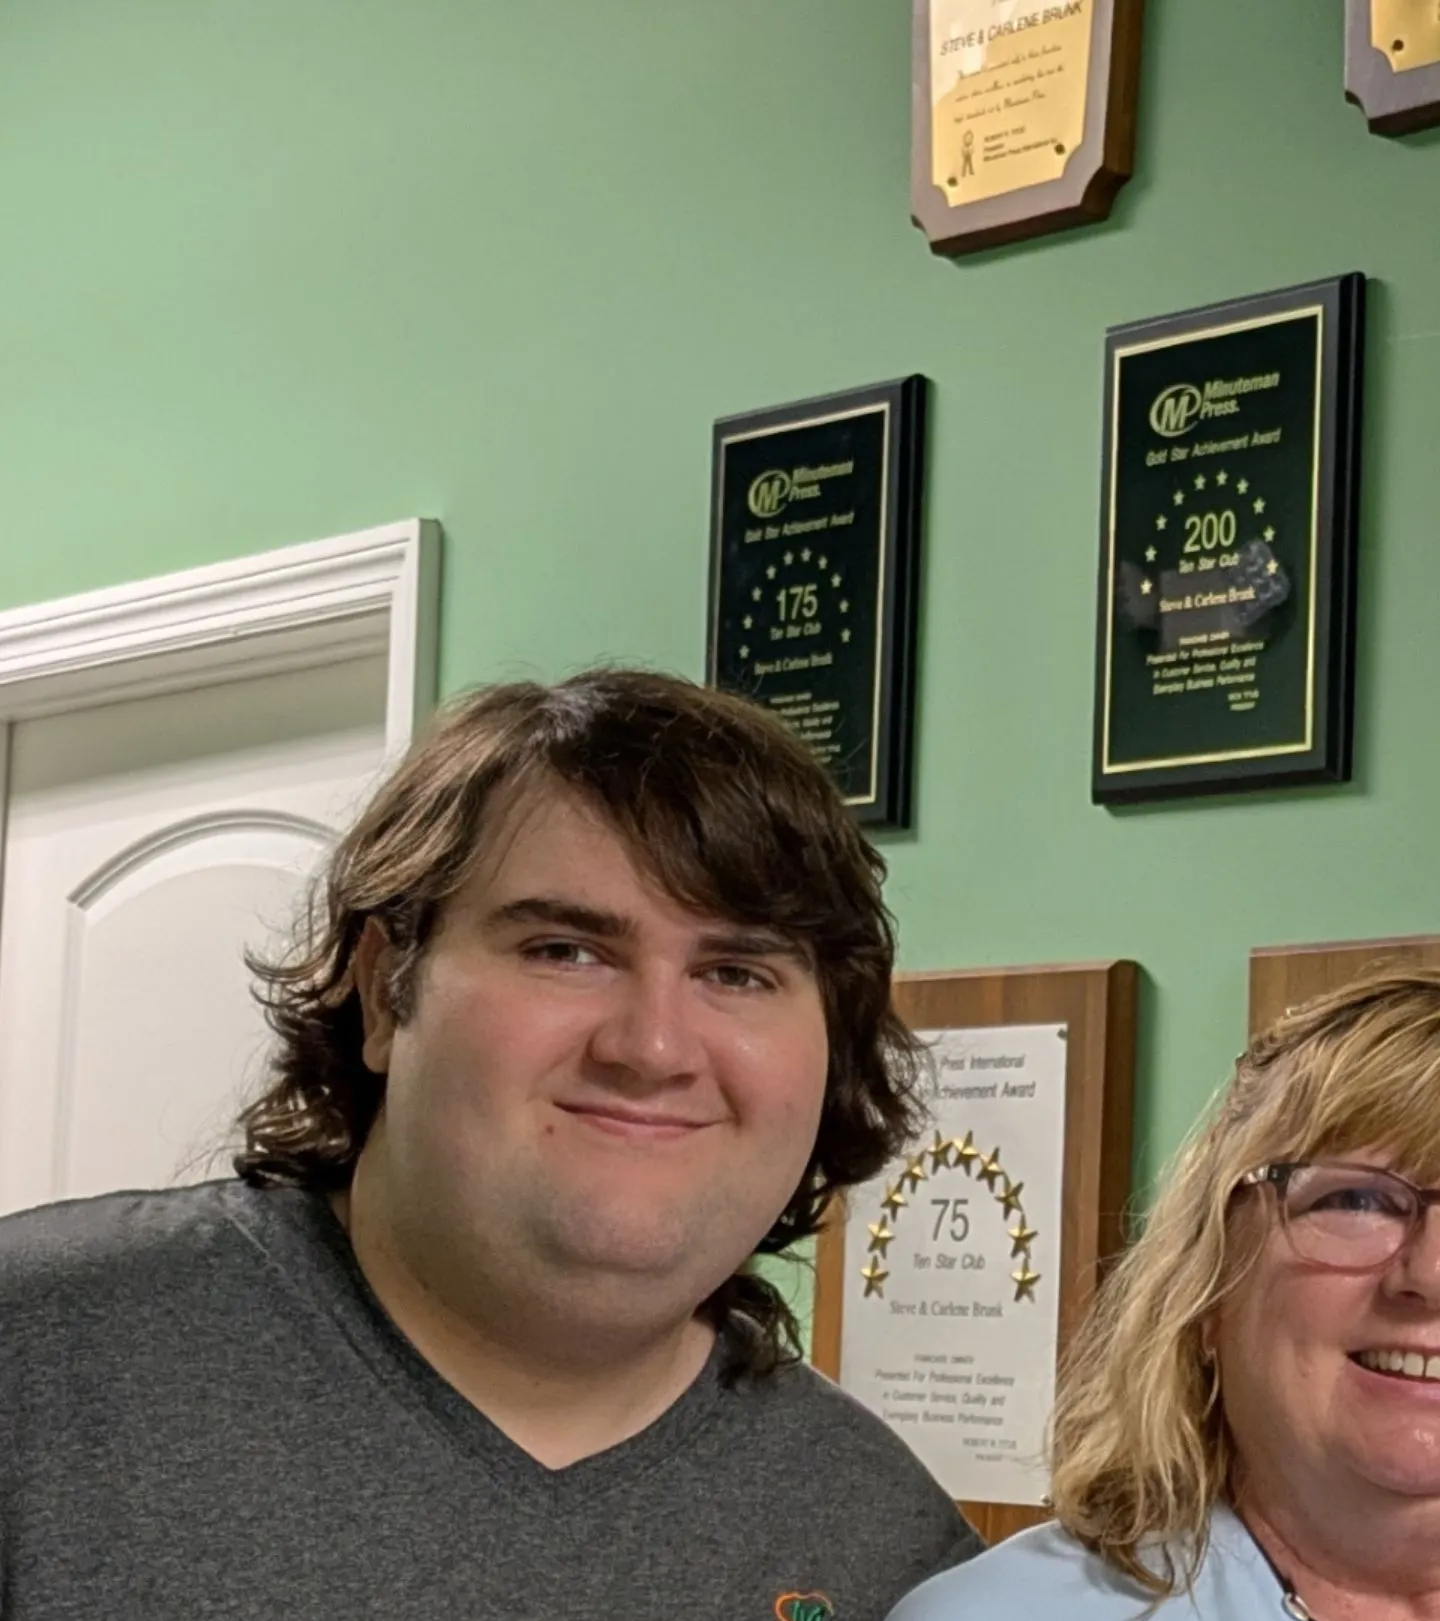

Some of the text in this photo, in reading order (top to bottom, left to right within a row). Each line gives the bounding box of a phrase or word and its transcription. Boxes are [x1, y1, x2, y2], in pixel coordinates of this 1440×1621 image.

[1204, 372, 1280, 400] Minuteman
[1184, 510, 1236, 553] 200
[777, 583, 817, 621] 175
[930, 1198, 970, 1242] 75
[935, 1253, 957, 1270] Star
